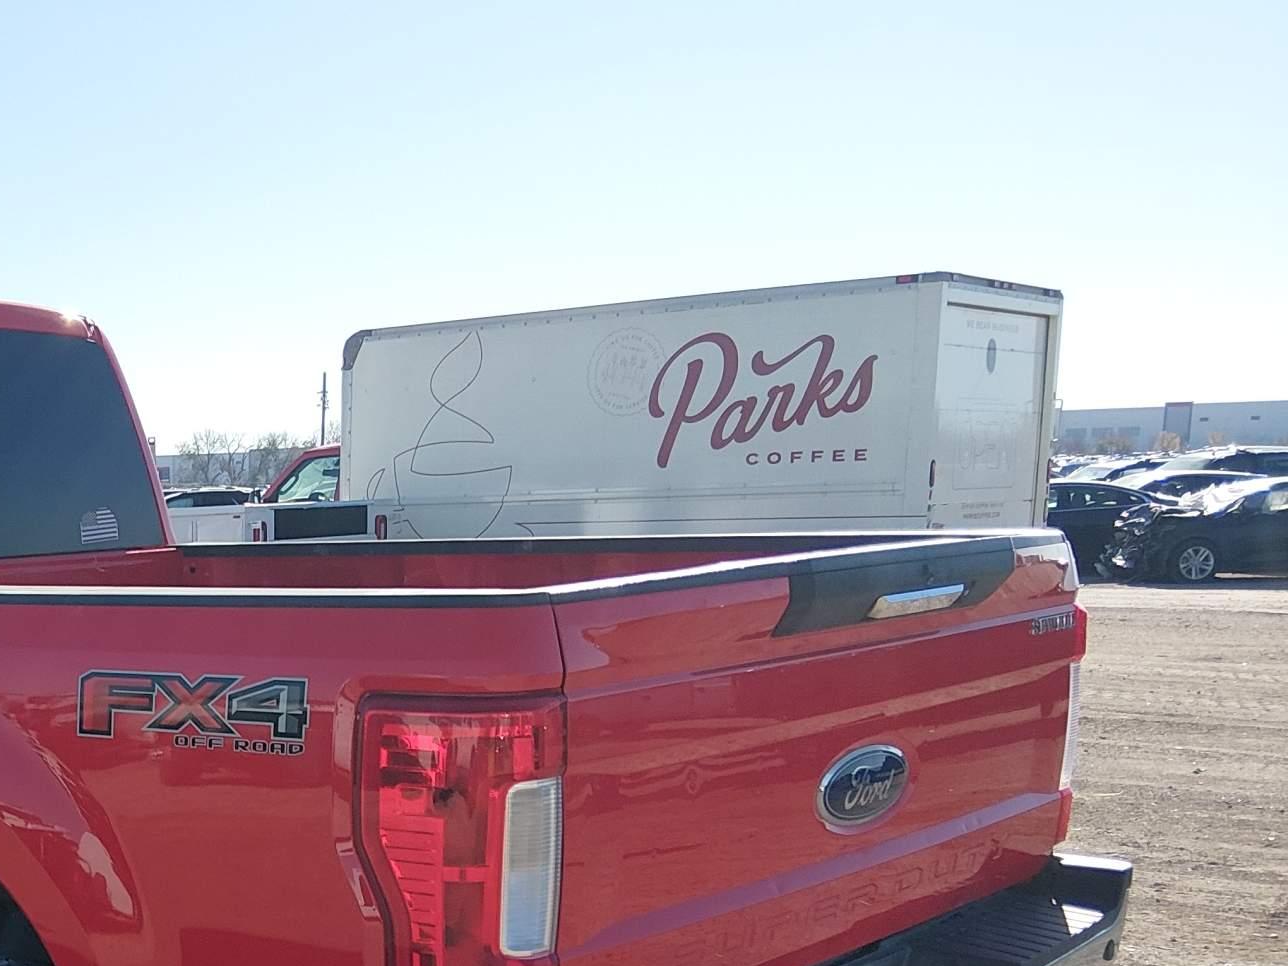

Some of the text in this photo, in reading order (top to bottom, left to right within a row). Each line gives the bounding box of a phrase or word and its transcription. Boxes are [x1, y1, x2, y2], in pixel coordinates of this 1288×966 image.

[648, 331, 879, 469] Parks
[745, 448, 868, 465] COFFEE
[77, 669, 310, 741] FX4
[173, 734, 305, 756] OFF ROAD
[841, 765, 896, 812] Ford
